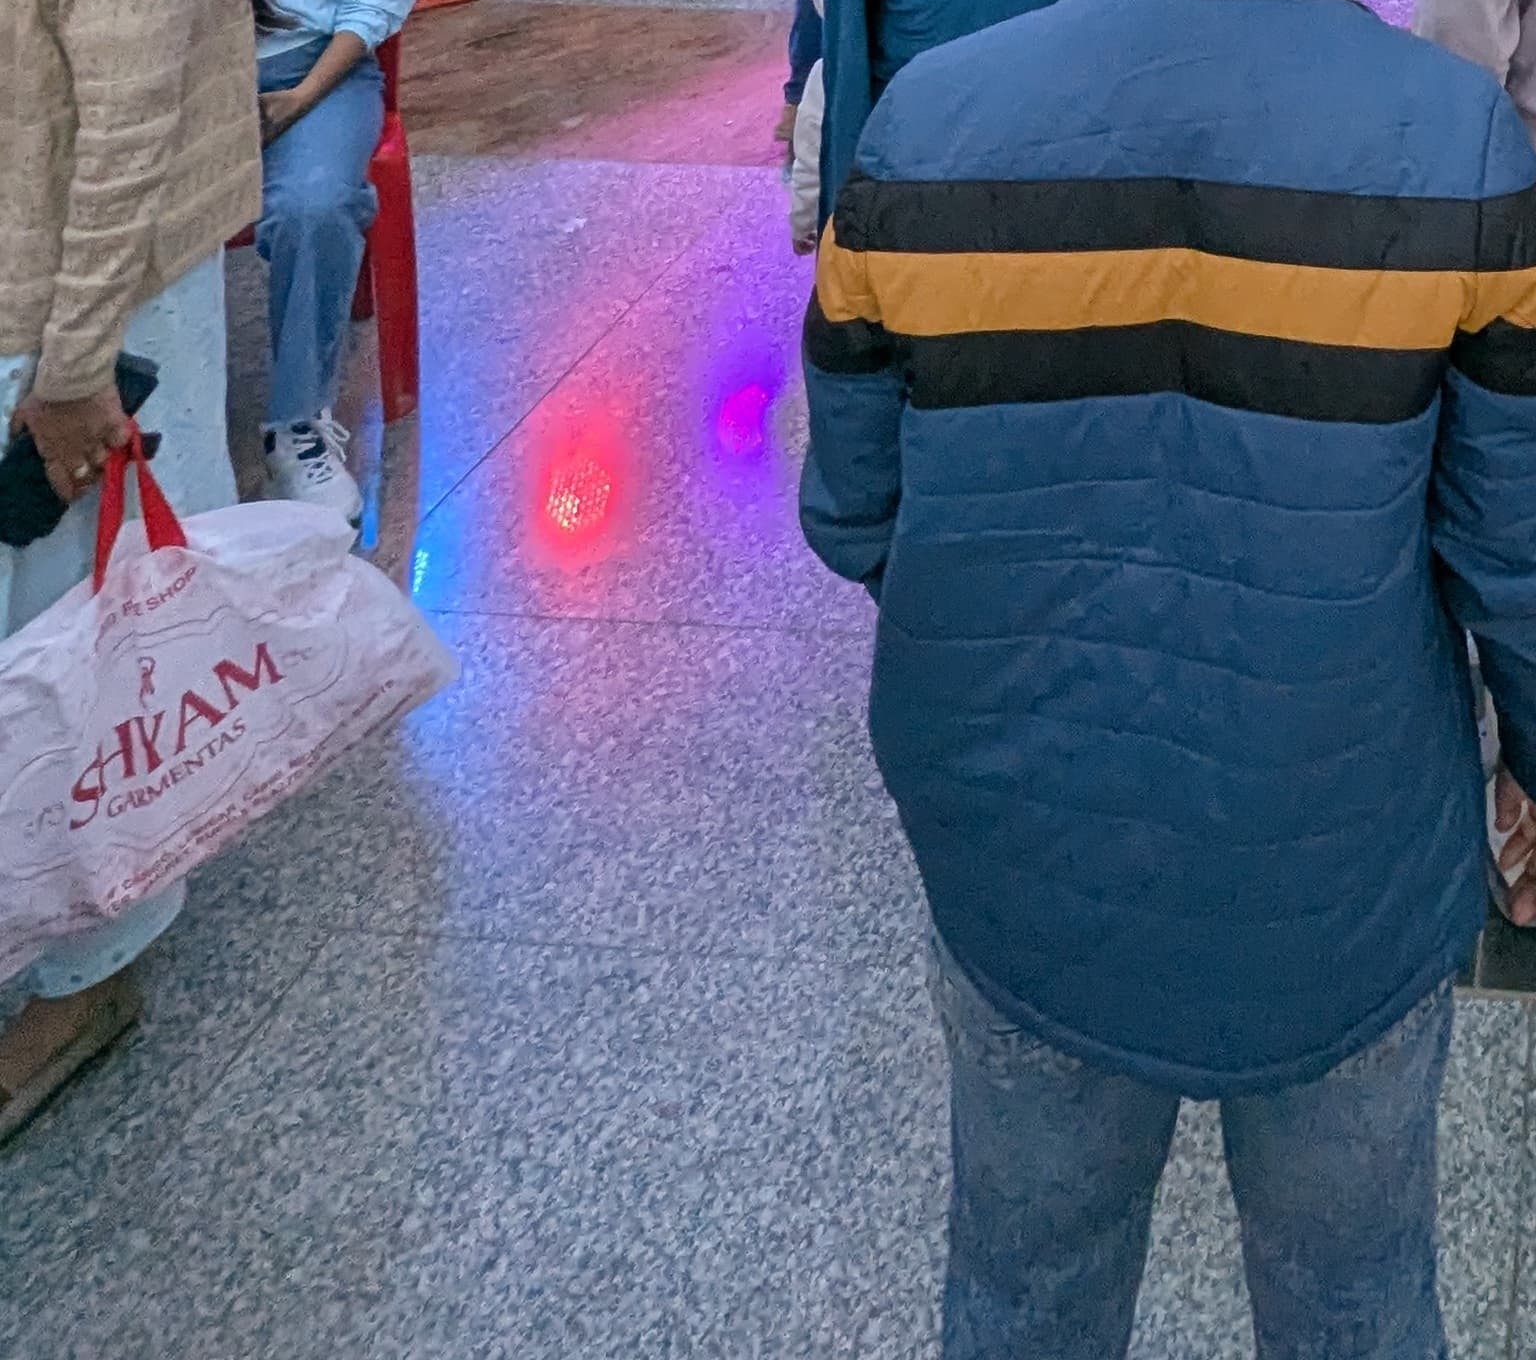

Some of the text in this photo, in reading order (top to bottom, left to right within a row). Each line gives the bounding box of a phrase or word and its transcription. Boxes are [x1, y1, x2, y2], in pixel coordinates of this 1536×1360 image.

[146, 566, 197, 611] SHOP
[69, 641, 287, 830] SHYAM
[106, 716, 247, 818] GARMENTAS
